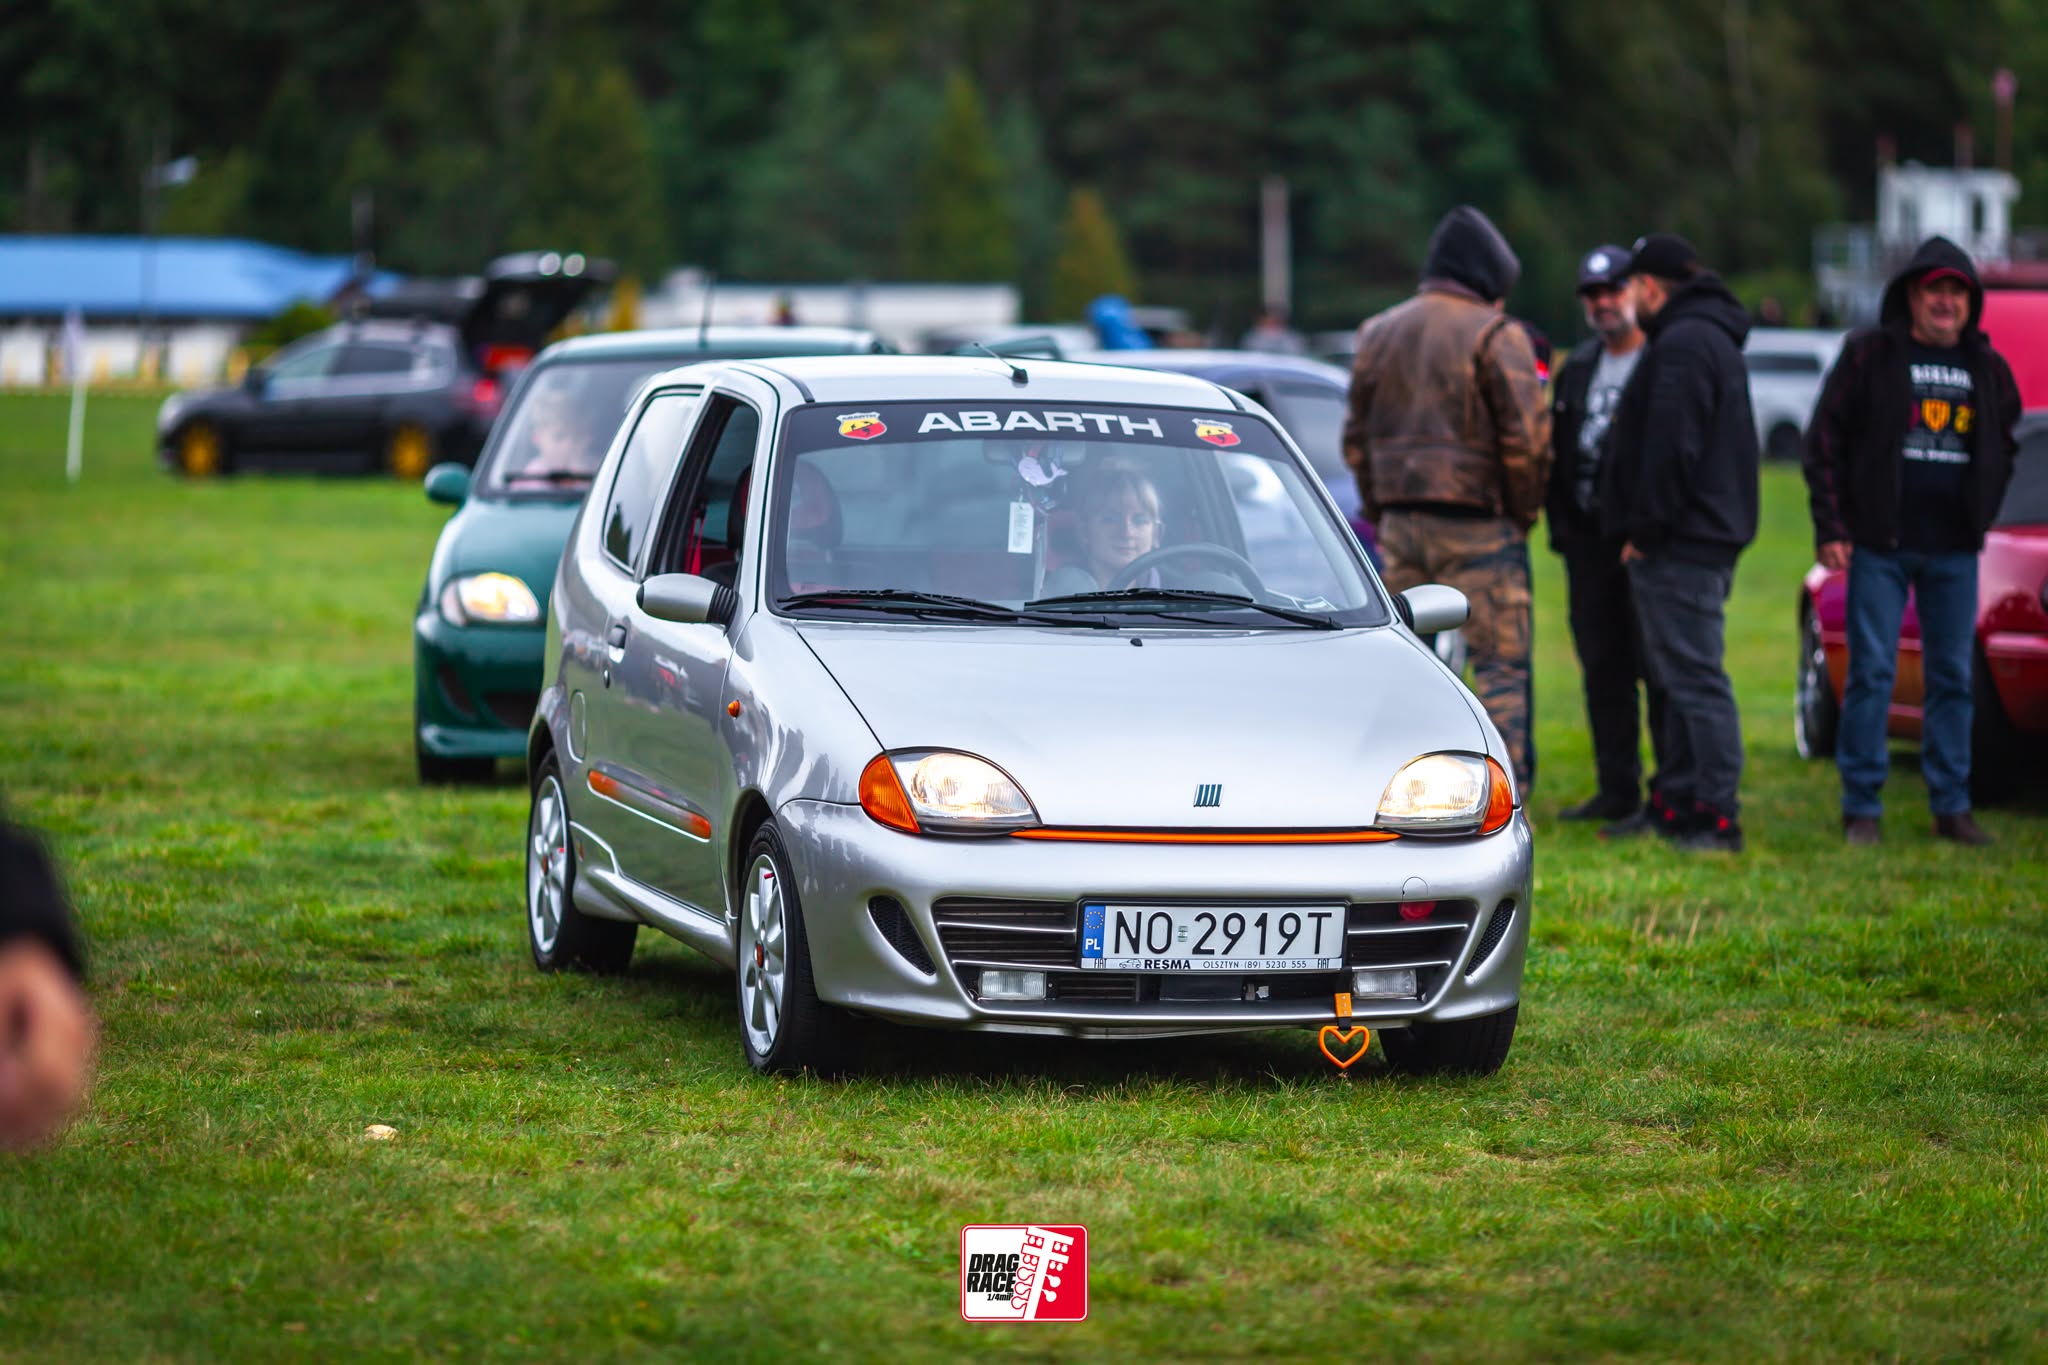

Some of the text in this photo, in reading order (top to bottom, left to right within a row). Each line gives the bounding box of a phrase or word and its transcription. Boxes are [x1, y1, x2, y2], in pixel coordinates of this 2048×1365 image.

[918, 411, 1164, 438] ABARTH
[1114, 911, 1332, 956] NO 2919T
[1085, 938, 1101, 950] PL
[1144, 959, 1307, 970] RESMA OLSZTYN (89) 5230 555
[1317, 958, 1331, 969] FIAT
